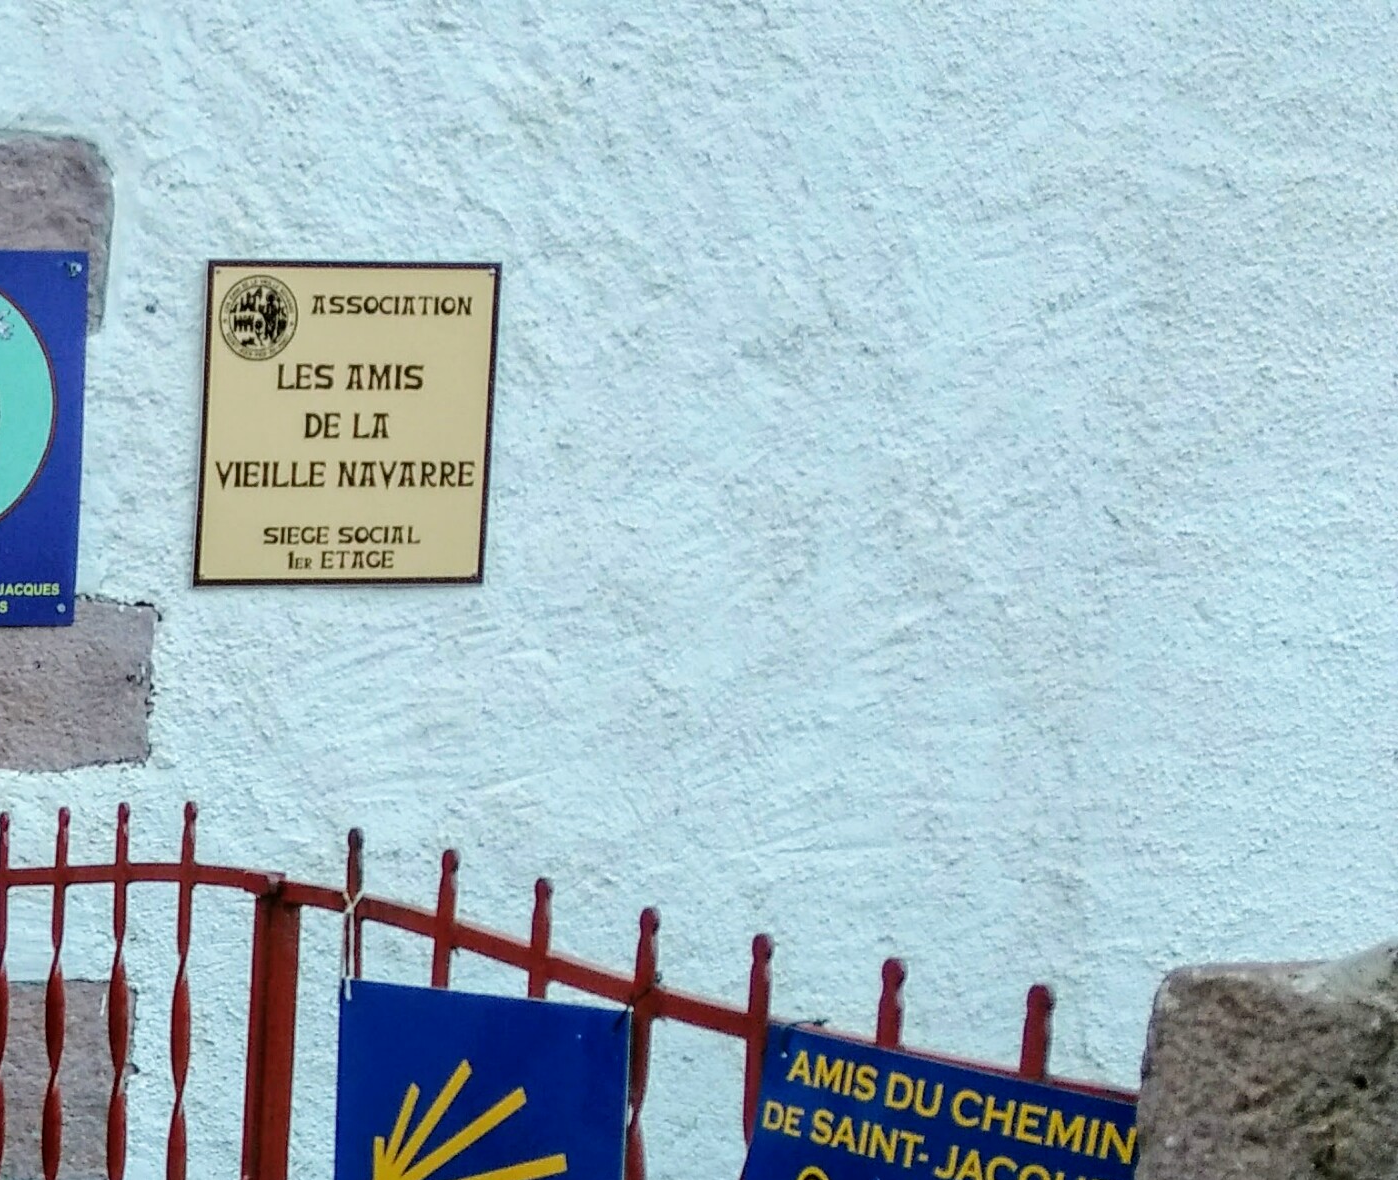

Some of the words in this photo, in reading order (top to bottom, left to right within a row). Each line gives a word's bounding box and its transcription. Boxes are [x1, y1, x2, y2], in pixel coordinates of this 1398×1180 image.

[311, 294, 473, 316] ASSOCIATION
[277, 364, 334, 390] LES
[345, 364, 424, 390] AMIS
[304, 413, 341, 439] DE
[352, 413, 389, 439] LA
[215, 461, 327, 488] VIEILLE
[337, 461, 476, 489] NAVARRE
[263, 526, 329, 544] SIEGE
[337, 526, 421, 545] SOCIAL
[287, 551, 313, 570] 1ER
[320, 550, 395, 569] ETAGE
[787, 1050, 878, 1102] AMIS
[885, 1070, 945, 1119] DU
[951, 1088, 1138, 1165] CHEMIN
[761, 1102, 803, 1138] DE
[810, 1108, 929, 1169] SAINT-
